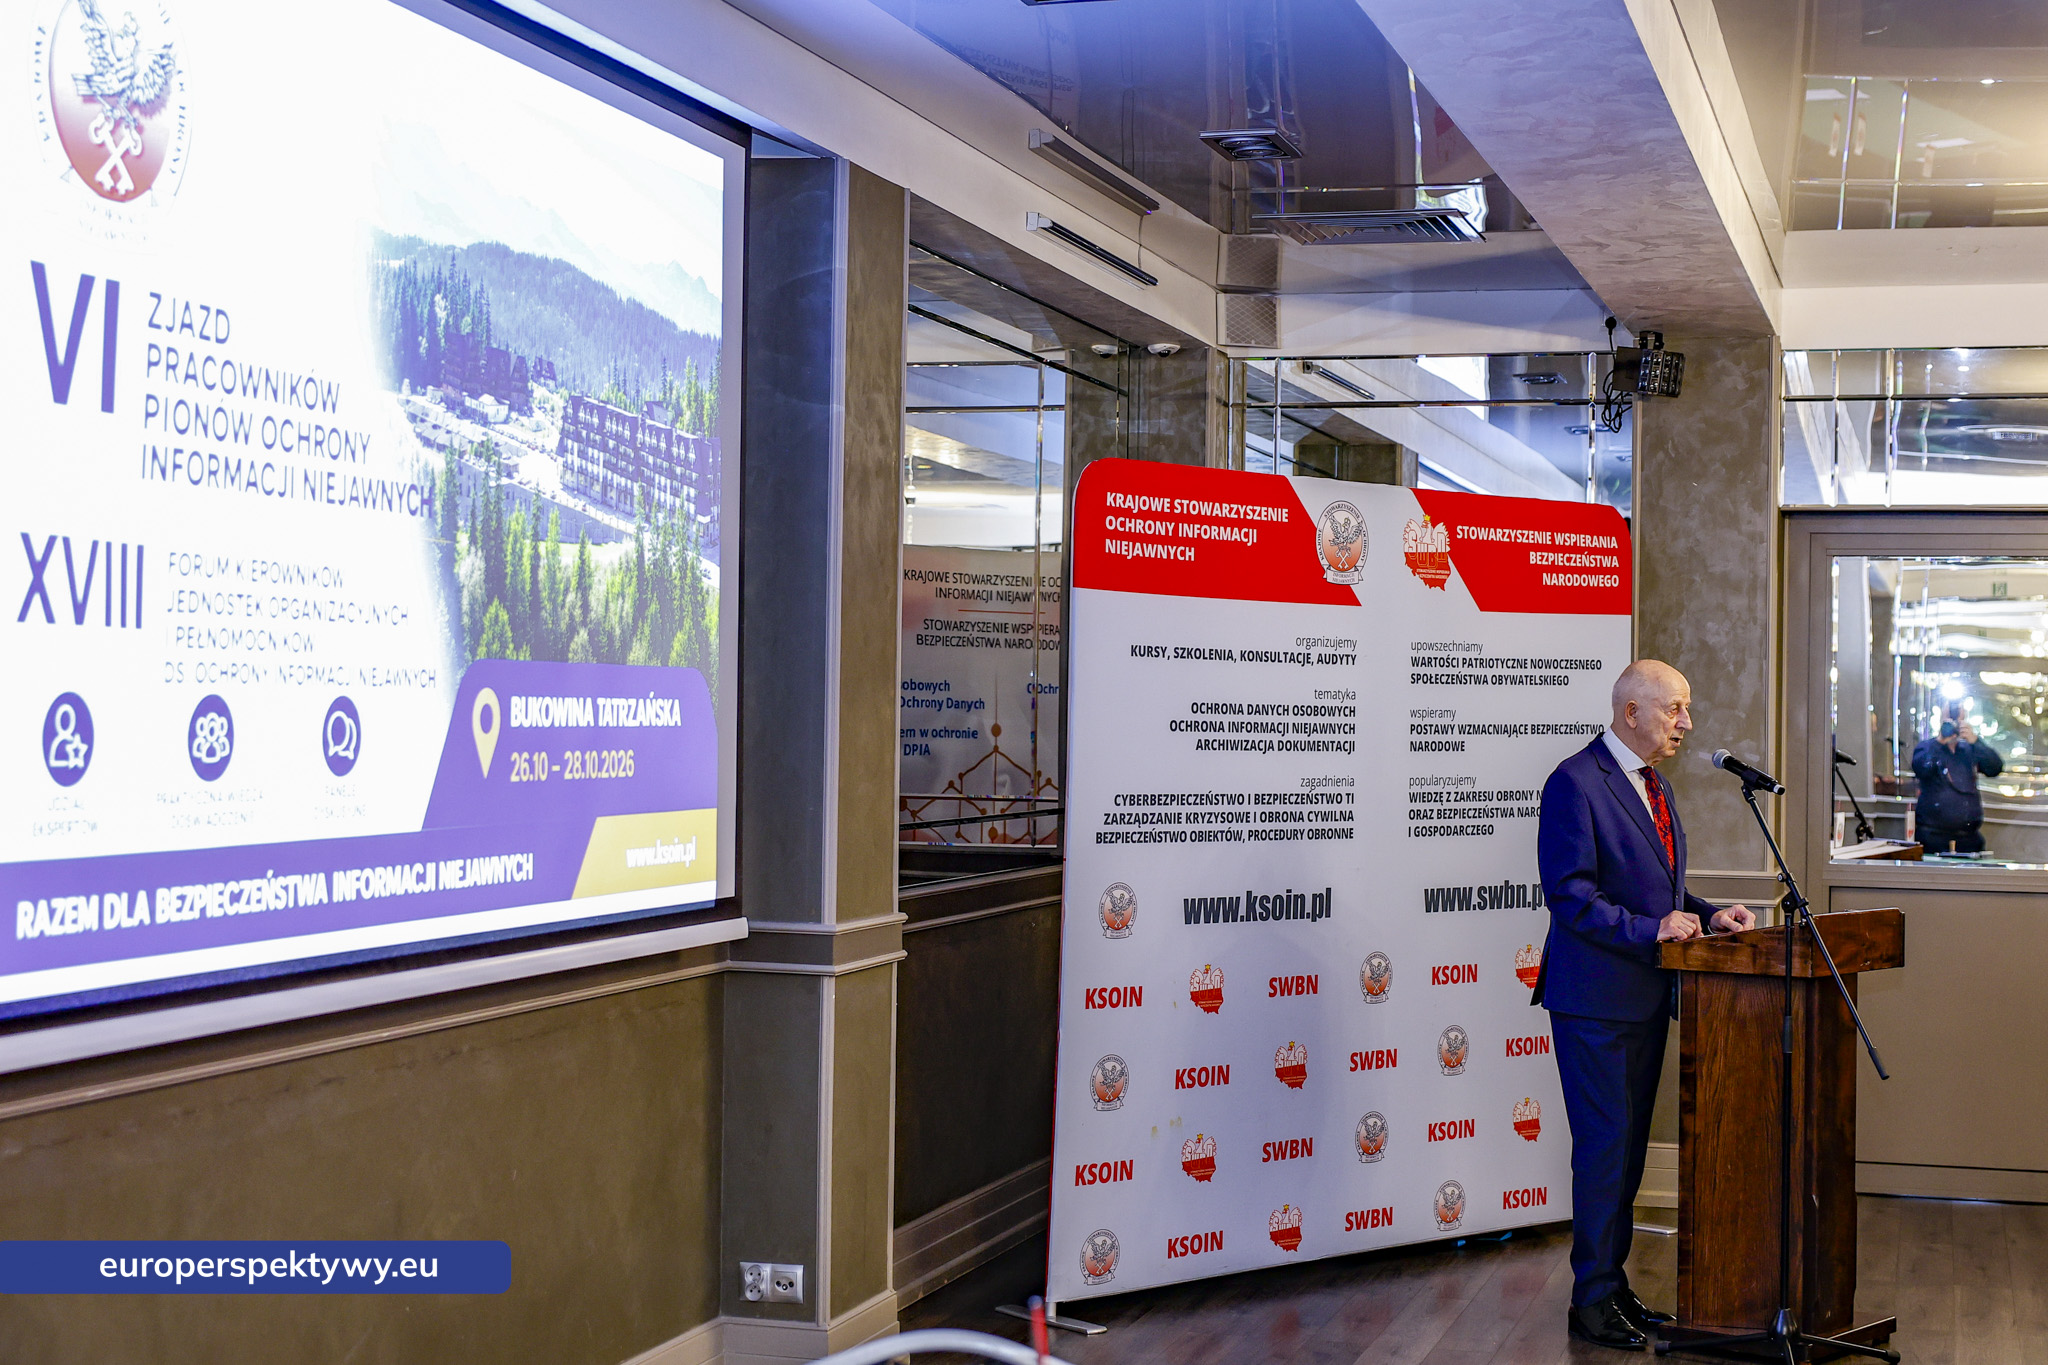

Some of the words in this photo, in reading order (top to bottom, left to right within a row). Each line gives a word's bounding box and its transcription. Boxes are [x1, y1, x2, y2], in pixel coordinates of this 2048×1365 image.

[147, 292, 231, 345] ZJAZD
[30, 260, 120, 414] VI
[147, 343, 340, 414] PRACOWNIKÓW
[144, 394, 253, 450] PIONÓW
[261, 418, 370, 465] OCHRONY
[142, 444, 295, 498] INFORMACJI
[303, 469, 434, 518] NIEJAWNYCH
[1106, 491, 1171, 513] KRAJOWE
[1173, 498, 1289, 523] STOWARZYSZENIE
[1105, 515, 1175, 537] OCHRONY
[1178, 523, 1257, 546] INFORMACJI
[1456, 525, 1552, 545] STOWARZYSZENIE
[1554, 533, 1618, 549] WSPIERANIA
[1105, 538, 1195, 562] NIEJAWNYCH
[1529, 551, 1619, 568] BEZPIECZEŃSTWA
[168, 552, 229, 578] FORUM
[16, 532, 144, 629] XVIII
[904, 569, 950, 584] KRAJOWE
[1542, 573, 1619, 588] NARODOWEGO
[935, 587, 993, 603] INFORMACJI
[167, 590, 263, 617] JEDNOSTEK
[269, 596, 408, 626] ORGANIZACYJNYCH
[923, 618, 1009, 634] STOWARZYSZENIE
[916, 633, 1001, 648] BEZPIECZEŃSTWA
[1295, 636, 1357, 652] organizujemy
[1410, 640, 1483, 655] upowszechniamy
[1130, 644, 1171, 660] KURSY,
[1173, 647, 1237, 663] SZKOLENIA,
[1240, 650, 1314, 667] KONSULTACJE,
[1316, 653, 1357, 666] AUDYTY
[1411, 656, 1459, 669] WARTOŚCI
[1462, 657, 1528, 669] PATRIOTYCZNE
[1530, 658, 1602, 670] NOWOCZESNEGO
[195, 661, 269, 684] OCHRONY
[1410, 672, 1489, 686] SPOŁECZEŃSTWA
[1491, 674, 1569, 686] OBYWATELSKIEGO
[900, 679, 950, 694] obowych
[1314, 688, 1356, 703] tematyka
[510, 695, 594, 729] BUKOWINA
[597, 695, 681, 728] TATRZAŃSKA
[946, 697, 985, 712] Danych
[1191, 701, 1244, 715] OCHRONA
[1247, 704, 1289, 716] DANYCH
[1292, 705, 1356, 717] OSOBOWYCH
[1410, 707, 1456, 721] wspieramy
[919, 729, 929, 738] w
[931, 726, 978, 739] ochronie
[1169, 719, 1225, 733] OCHRONA
[1228, 721, 1289, 737] INFORMACJI
[1292, 723, 1356, 737] NIEJAWNYCH
[1410, 724, 1455, 735] POSTAWY
[1457, 723, 1528, 738] WZMACNIAJĄCE
[1530, 721, 1605, 735] BEZPIECZEŃSTWO
[903, 743, 931, 756] DPIA
[1195, 739, 1275, 754] ARCHIWIZACJA
[1277, 740, 1355, 755] DOKUMENTACJI
[1409, 740, 1465, 752] NARODOWE
[510, 751, 548, 782] 26.10
[564, 749, 635, 780] 28.10.2026
[1300, 775, 1355, 790] zagadnienia
[1409, 774, 1476, 789] popularyzujemy
[1114, 791, 1245, 807] CYBERBEZPIECZEŃSTWO
[1247, 794, 1251, 805] I
[1254, 790, 1343, 805] BEZPIECZEŃSTWO
[1345, 792, 1355, 804] TI
[1409, 791, 1444, 806] WIEDZĘ
[1445, 791, 1451, 803] Z
[1454, 791, 1494, 803] ZAKRESU
[1496, 790, 1534, 802] OBRONY
[1103, 812, 1182, 828] ZARZĄDZANIE
[1185, 811, 1251, 824] KRYZYSOWE
[1253, 812, 1257, 823] I
[1259, 810, 1305, 823] OBRONA
[1307, 810, 1354, 822] CYWILNA
[1408, 808, 1434, 820] ORAZ
[1436, 805, 1515, 820] BEZPIECZEŃSTWA
[1095, 828, 1187, 844] BEZPIECZEŃSTWO
[1190, 826, 1246, 843] OBIEKTÓW,
[1248, 829, 1305, 841] PROCEDURY
[1307, 827, 1354, 840] OBRONNE
[1413, 824, 1494, 837] GOSPODARCZEGO
[626, 835, 696, 870] www.ksoin.pl
[16, 893, 99, 941] RAZEM
[103, 889, 150, 930] DLA
[155, 869, 328, 923] BEZPIECZEŃSTWA
[332, 861, 435, 908] INFORMACJI
[438, 853, 533, 892] NIEJAWNYCH
[1183, 887, 1332, 924] www.ksoin.pl
[1424, 880, 1547, 913] www.swbn.p
[1431, 964, 1478, 985] KSOIN
[1268, 974, 1319, 998] SWBN
[1085, 986, 1143, 1009] KSOIN
[1505, 1035, 1550, 1057] KSOIN
[1349, 1048, 1398, 1072] SWBN
[1175, 1064, 1230, 1090] KSOIN
[1428, 1118, 1475, 1143] KSOIN
[1261, 1137, 1313, 1162] SWBN
[1074, 1159, 1134, 1186] KSOIN
[1502, 1186, 1548, 1210] KSOIN
[1344, 1206, 1394, 1232] SWBN
[1167, 1230, 1224, 1259] KSOIN
